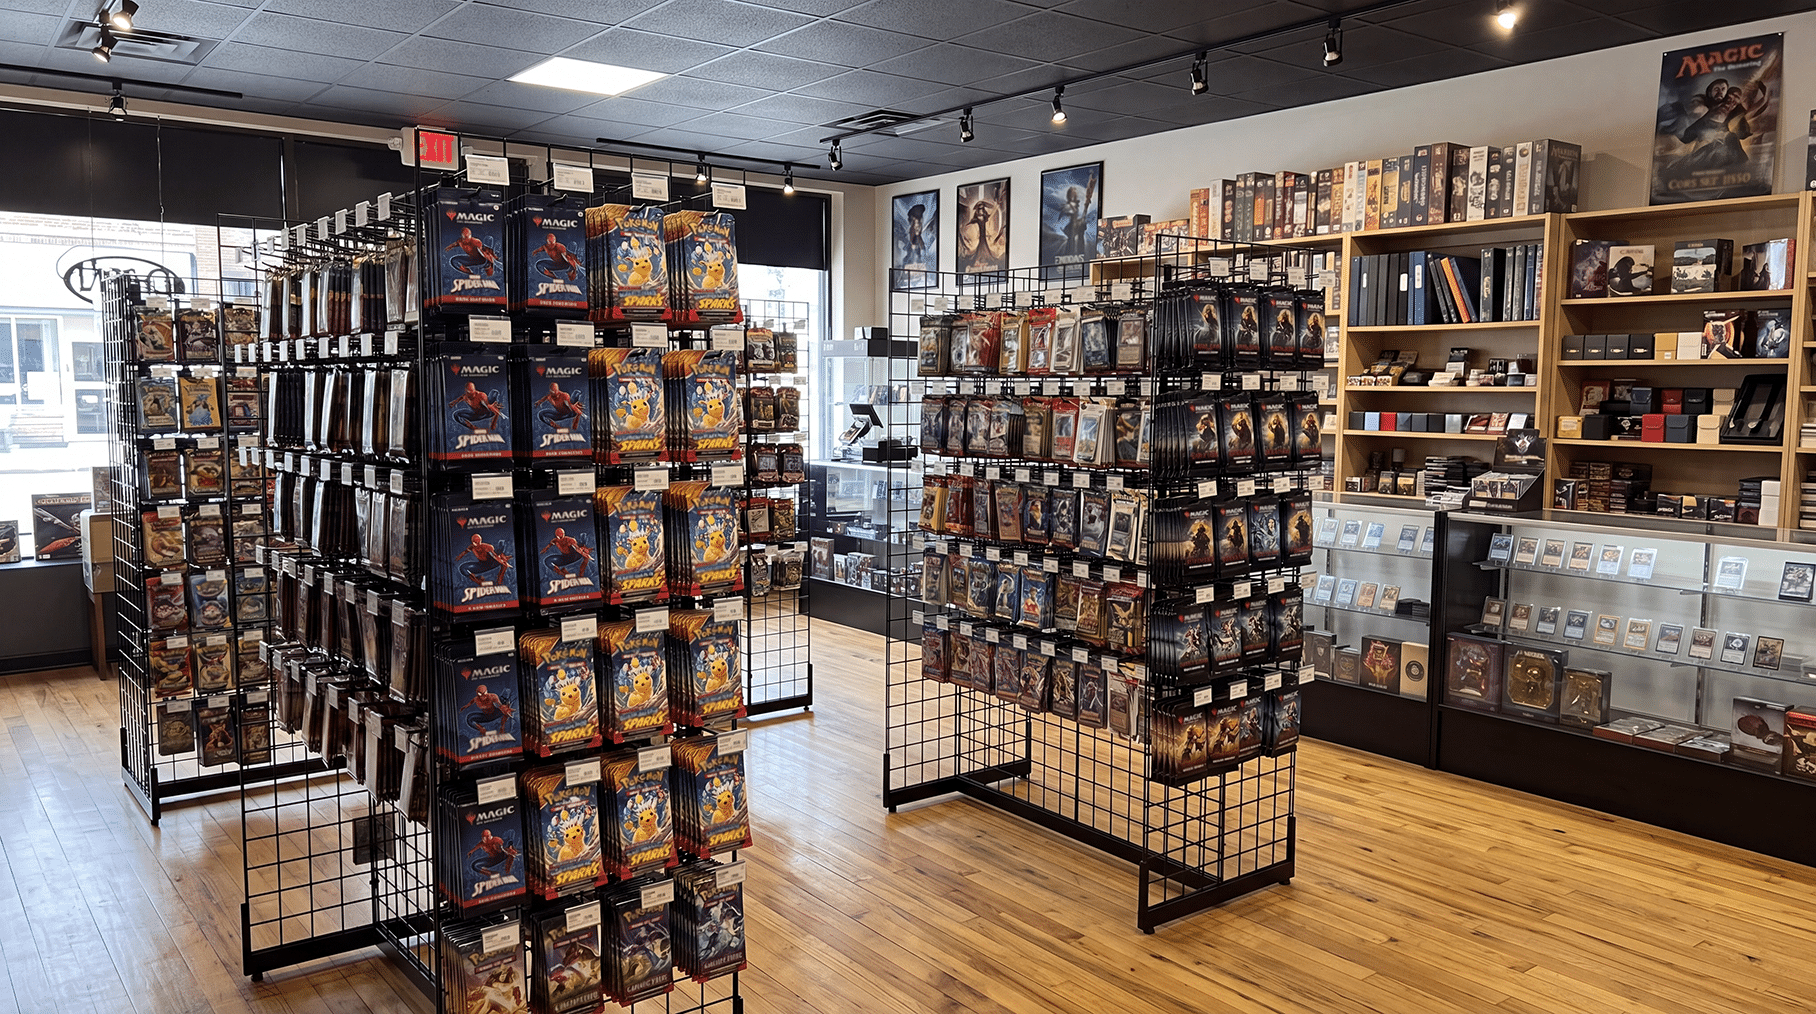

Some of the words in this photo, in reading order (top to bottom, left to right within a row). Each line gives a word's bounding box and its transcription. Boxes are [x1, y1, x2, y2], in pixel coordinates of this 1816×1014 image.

[1676, 44, 1764, 79] MAGIC
[412, 131, 454, 163] EXIT
[456, 212, 495, 222] MAGIC
[541, 218, 578, 228] MAGIC
[460, 365, 500, 374] MAGIC
[545, 367, 582, 375] MAGIC
[550, 509, 588, 520] MAGIC
[466, 515, 507, 526] MAGIC
[471, 664, 511, 678] MAGIC
[476, 805, 515, 822] MAGIC
